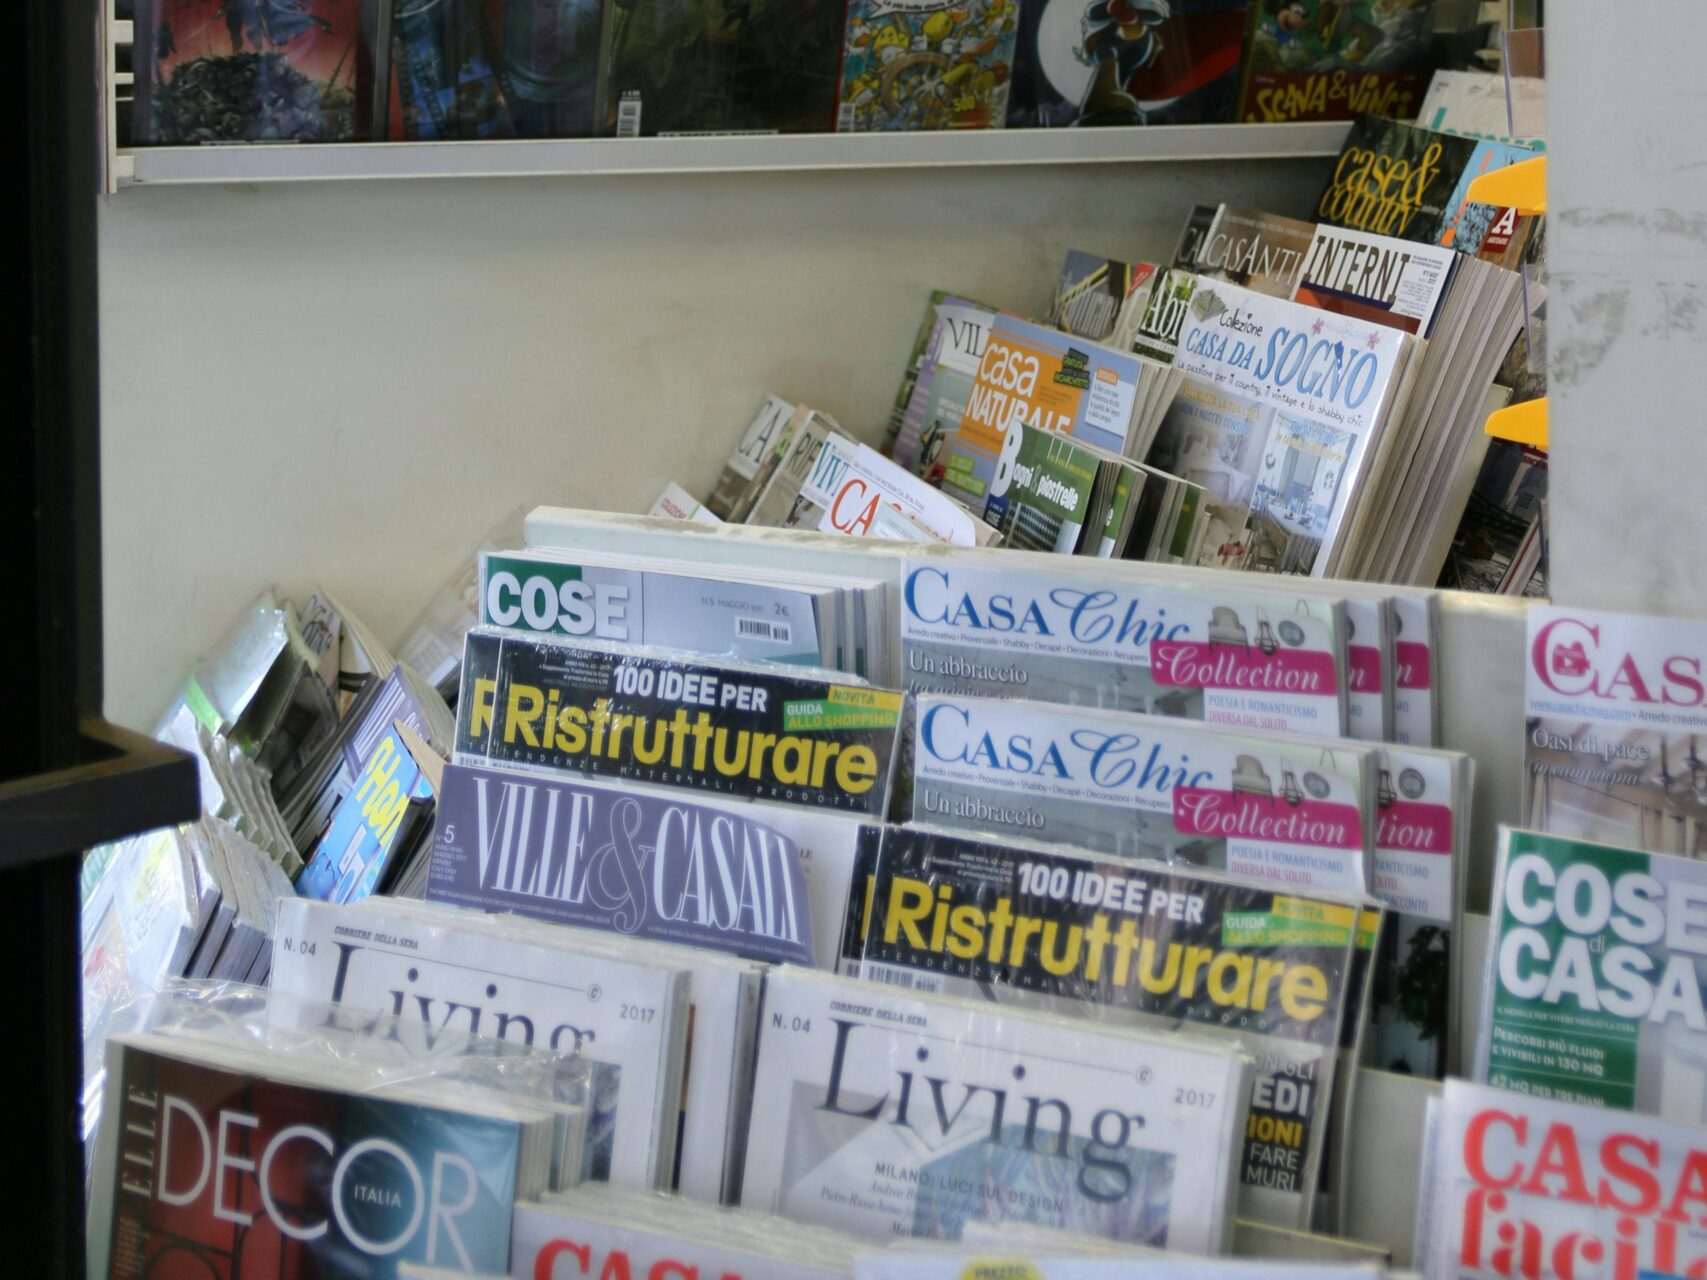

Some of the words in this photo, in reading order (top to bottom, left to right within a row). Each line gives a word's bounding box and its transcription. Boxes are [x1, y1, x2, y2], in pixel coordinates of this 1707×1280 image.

[1304, 234, 1411, 305] INTERNI
[979, 342, 1041, 398] casa
[1186, 327, 1229, 362] CASA
[1227, 341, 1257, 370] DA
[1254, 326, 1379, 410] SOGNO
[1215, 373, 1227, 384] per
[1235, 378, 1262, 397] country,
[1272, 388, 1298, 407] vintage
[1317, 404, 1345, 424] shabby
[1347, 414, 1363, 428] chic
[1036, 472, 1080, 513] piastrelle
[487, 570, 629, 641] COSE
[904, 566, 1055, 637] CASA
[1049, 587, 1191, 647] Chic
[908, 649, 936, 672] Un
[939, 655, 1029, 685] abbraccio
[1114, 649, 1148, 663] Recupero
[1158, 645, 1320, 691] Collection
[613, 665, 654, 698] 100
[657, 671, 719, 706] IDEE
[720, 682, 768, 713] PER
[1208, 694, 1240, 709] POESIA
[1248, 698, 1318, 720] ROMANTICISMO
[786, 703, 824, 716] GUIDA
[788, 714, 823, 729] ALLO
[825, 713, 895, 728] SHOPPING
[1208, 710, 1242, 726] DIVERSA
[1243, 713, 1259, 728] DAL
[503, 682, 879, 795] Ristrutturare
[920, 703, 1075, 780] CASA
[1069, 729, 1214, 792] Chic
[1531, 727, 1575, 751] Oasi
[1578, 732, 1600, 755] di
[1604, 739, 1651, 762] pace
[1020, 779, 1048, 794] Shabby
[1085, 789, 1130, 803] Decorazioni
[1134, 795, 1171, 810] Recupero
[1550, 762, 1640, 793] campagna
[923, 789, 951, 813] Un
[955, 797, 1046, 829] abbraccio
[1180, 792, 1346, 845] Collection
[472, 777, 594, 904] VILLE
[586, 797, 656, 934] &
[1231, 844, 1264, 860] POESIA
[1273, 850, 1344, 875] ROMANTICISMO
[1231, 862, 1265, 878] DIVERSA
[1266, 866, 1283, 880] DAL
[1017, 862, 1069, 901] 100
[1072, 872, 1146, 914] IDEE
[1149, 888, 1205, 924] PER
[1226, 914, 1268, 930] GUIDA
[300, 941, 317, 956] 04
[400, 936, 419, 950] SERA
[882, 876, 1329, 1022] Ristrutturare
[1589, 934, 1606, 954] di
[1498, 927, 1707, 1032] CASA
[619, 1004, 656, 1023] 2017
[792, 1017, 811, 1034] 04
[829, 1000, 875, 1018] CORRIERE
[876, 1007, 905, 1023] DELLA
[906, 1013, 928, 1027] SERA
[1493, 1026, 1546, 1049] PERCORSI
[1569, 1044, 1605, 1060] FLUIDI
[1558, 1056, 1580, 1071] 130
[815, 1017, 1146, 1204] Living
[1174, 1086, 1217, 1110] 2017
[1250, 1144, 1299, 1171] FARE
[157, 1095, 478, 1274] DECOR
[875, 1161, 938, 1186] MILANO:
[939, 1177, 976, 1197] LUCI
[1007, 1190, 1064, 1213] DESIGN
[1246, 1164, 1296, 1192] MURI
[353, 1185, 402, 1208] ITALIA
